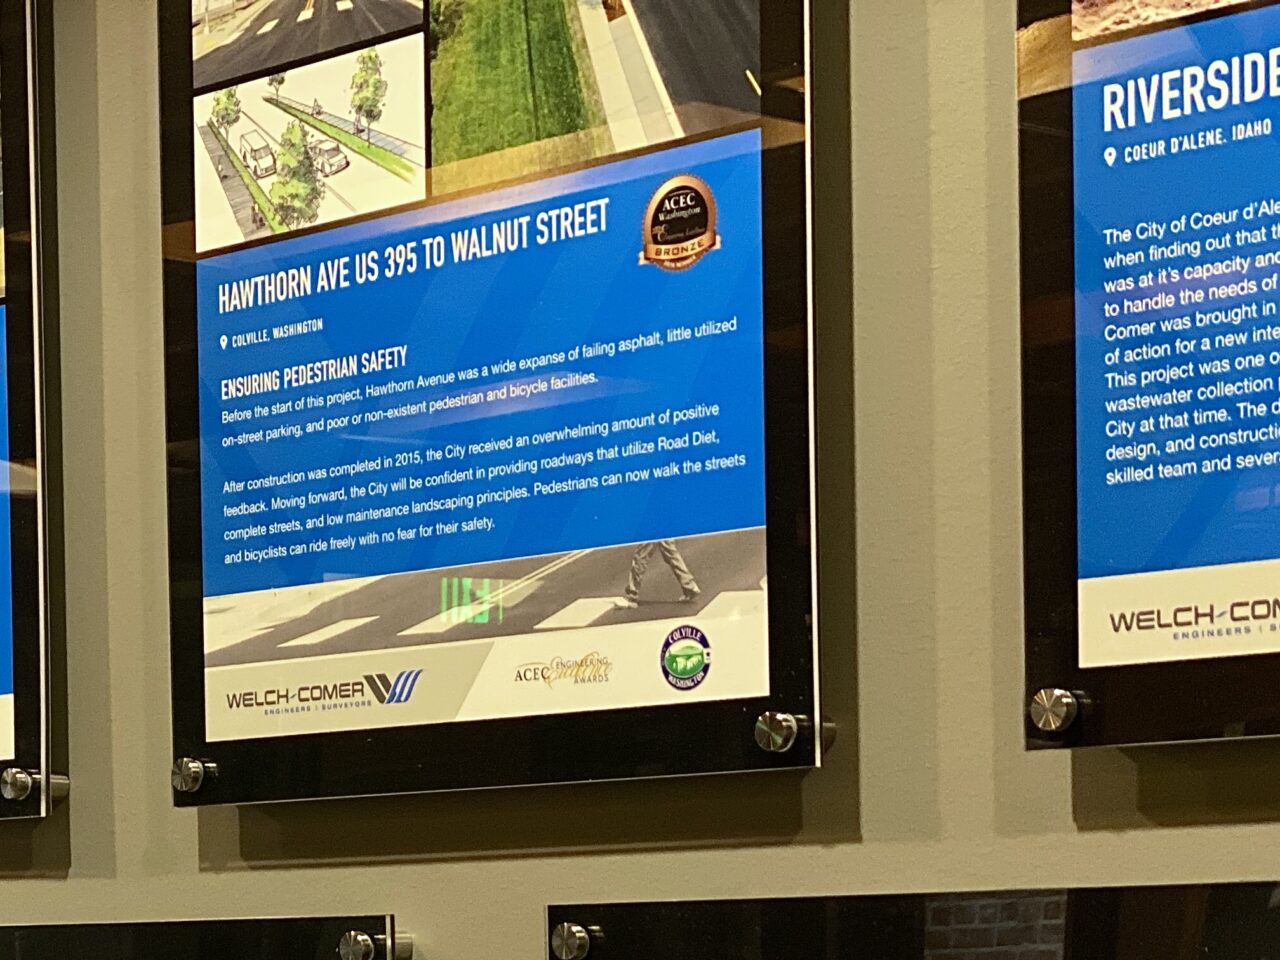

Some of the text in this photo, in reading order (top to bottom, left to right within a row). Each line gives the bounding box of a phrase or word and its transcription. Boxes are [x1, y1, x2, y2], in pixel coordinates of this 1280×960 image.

[1104, 46, 1280, 132] RIVERSIDE
[1124, 140, 1166, 163] COEUR
[1232, 118, 1272, 141] IDAHO
[662, 192, 696, 211] ACEC
[658, 206, 701, 222] Washington
[218, 265, 311, 314] HAWTHORN
[316, 256, 350, 293] AVE
[355, 250, 379, 284] US
[384, 241, 417, 278] 395
[421, 235, 445, 270] TO
[450, 215, 530, 263] WALNUT
[536, 197, 609, 245] STREET
[655, 238, 705, 256] BRONZE
[1103, 276, 1135, 293] was
[1138, 271, 1154, 288] at
[1157, 266, 1181, 285] it's
[1183, 256, 1251, 281] capacity
[272, 317, 323, 339] WASHINGTON
[221, 316, 737, 424] Before the start of this project, Hawthorn Avenue was a wide expanse of failing asphalt, little utilized
[221, 345, 407, 398] ENSURING PEDESTRIAN SAFETY
[668, 626, 702, 644] COLVILLE
[1172, 625, 1252, 640] ENGINEERS
[514, 666, 550, 682] ACEC
[574, 674, 609, 684] AWARDS
[668, 672, 705, 688] WASHINGTON
[264, 700, 372, 716] ENGINEERS SURVEYORS
